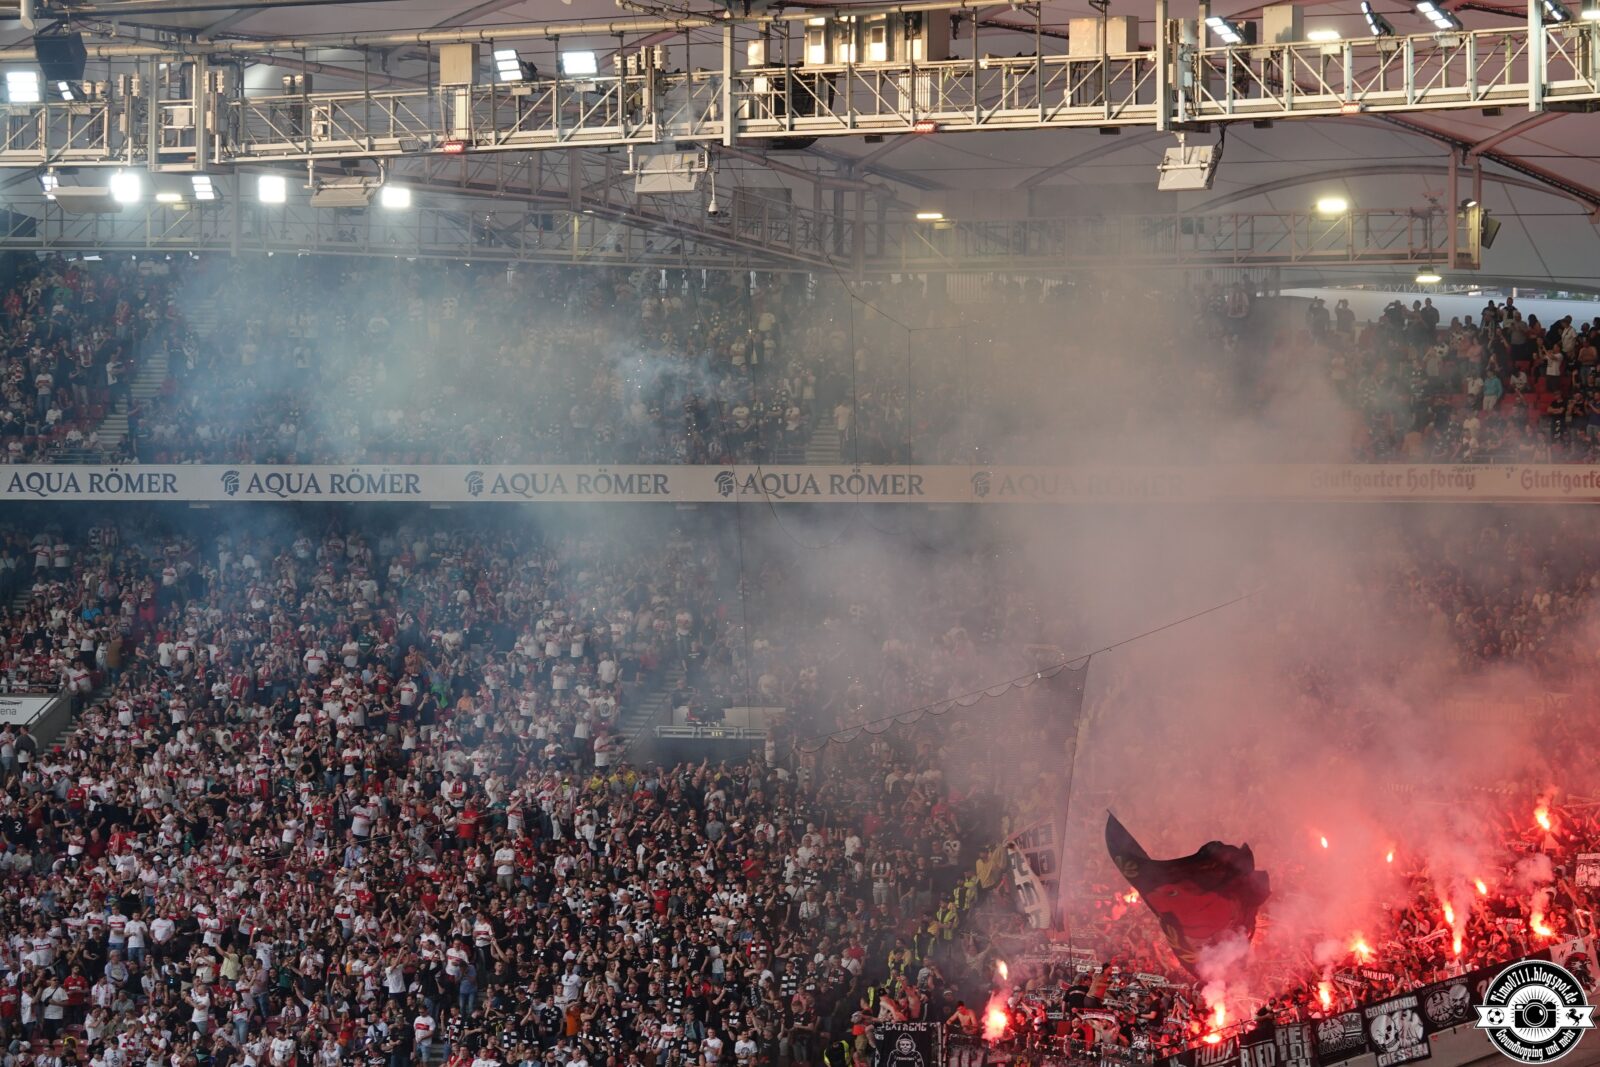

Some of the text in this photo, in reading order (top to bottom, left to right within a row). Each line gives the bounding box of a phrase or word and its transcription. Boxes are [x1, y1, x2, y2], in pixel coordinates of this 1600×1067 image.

[7, 468, 178, 497] AQUA RÖMER
[245, 468, 421, 497] AQUA RÖMER
[490, 468, 670, 498] AQUA RÖMER
[741, 468, 925, 498] AQUA RÖMER
[998, 474, 1077, 499] AQUA
[1311, 469, 1403, 492] Stuttgarter
[1364, 995, 1418, 1019] COMMANDO
[1194, 1039, 1234, 1066] FULDA
[1378, 1042, 1429, 1067] GIESSEN
